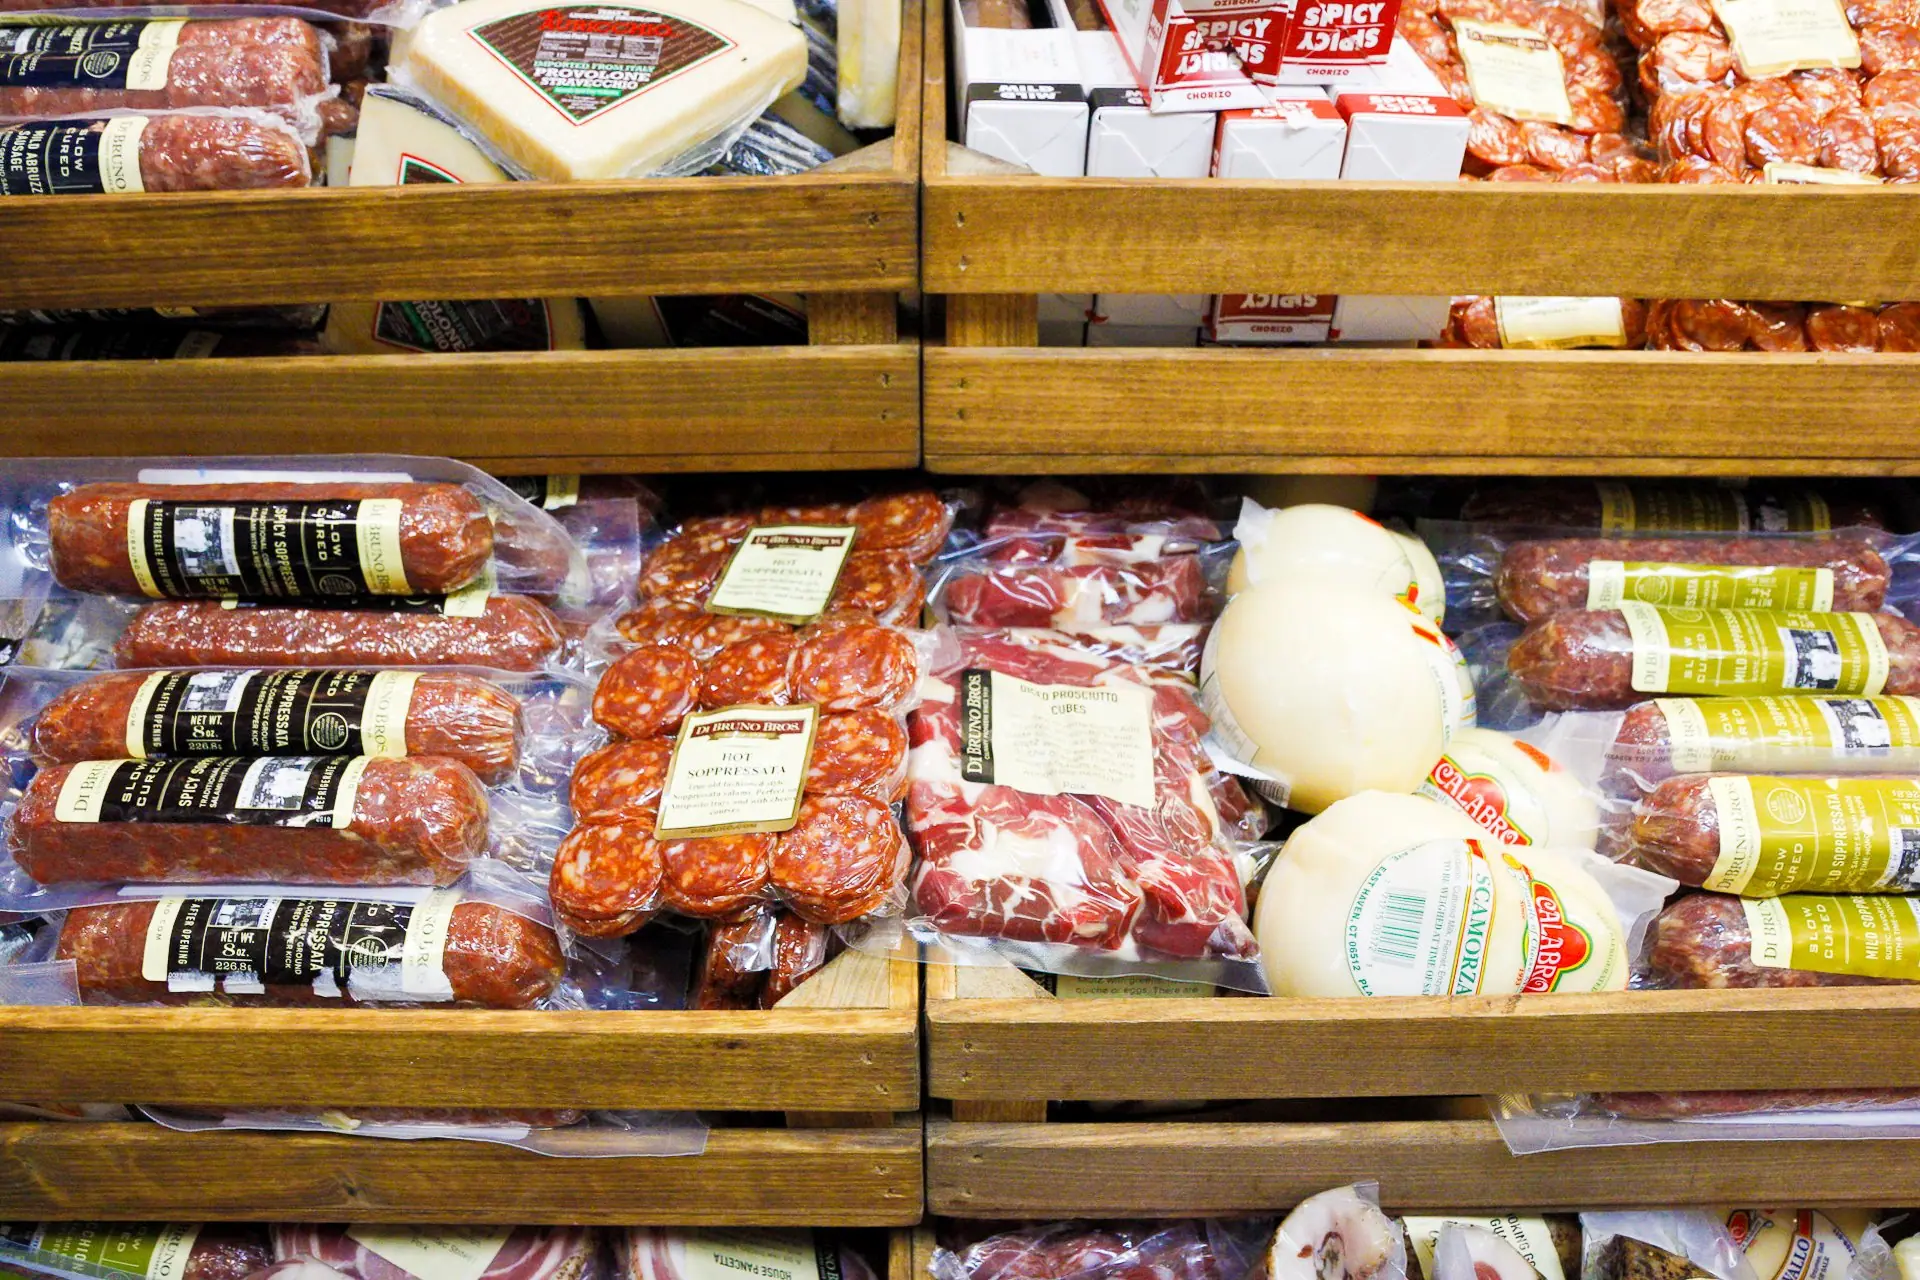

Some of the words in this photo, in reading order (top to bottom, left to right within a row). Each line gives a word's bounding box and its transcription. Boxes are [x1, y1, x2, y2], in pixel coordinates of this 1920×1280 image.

[533, 60, 590, 71] IMPORTED
[592, 63, 624, 72] FROM
[625, 64, 656, 74] ITALY
[533, 67, 652, 82] PROVOLONE
[1306, 67, 1350, 77] CHORIZO
[540, 76, 639, 90] STRAVECCHIO
[1186, 90, 1232, 100] CHORIZO
[10, 129, 29, 172] SAUSAGE
[27, 129, 47, 150] MILD
[74, 128, 90, 172] SLOW
[59, 127, 74, 177] CURED
[111, 133, 128, 189] BRUNO
[25, 151, 45, 195] ABRUZZ
[1250, 325, 1293, 333] CHORIZO
[152, 507, 165, 557] REFRIGERATE
[273, 507, 288, 538] SPICY
[1684, 637, 1695, 679] SLW
[1644, 669, 1658, 686] DI
[1734, 658, 1748, 684] MILD
[156, 692, 171, 712] AFTER
[257, 690, 265, 703] RED
[263, 687, 277, 720] COARSELY
[1052, 690, 1118, 703] PROSCIUTTO
[190, 715, 207, 725] NET
[209, 715, 223, 726] WT.
[251, 703, 262, 730] PEPPER
[276, 678, 302, 747] SOPPRESSATA
[1051, 704, 1087, 715] CUBES
[152, 713, 164, 748] OPENING
[192, 725, 205, 738] 8
[251, 729, 259, 747] KICK
[260, 720, 271, 751] GROUND
[696, 725, 710, 735] DI
[712, 720, 761, 732] BRUNO
[762, 721, 800, 732] BROS.
[966, 709, 982, 756] BRUNO
[722, 752, 753, 761] HOT
[967, 757, 983, 774] DI
[121, 762, 148, 803] SLOW
[136, 761, 166, 807] CURED
[688, 765, 787, 779] SOPPRESSATA
[178, 777, 201, 807] SPICY
[209, 782, 224, 808] SALAMI
[313, 765, 337, 810] REFRIGERATE
[673, 791, 721, 801] Soppressata
[755, 787, 786, 796] Perfect
[73, 795, 90, 812] DI
[732, 798, 749, 806] and
[1434, 762, 1520, 846] CALABRO
[1827, 793, 1848, 867] SOPPRESSATA
[1443, 860, 1452, 871] TO
[1717, 874, 1733, 890] DI
[1726, 827, 1747, 877] BRUNO
[1780, 842, 1804, 891] CURED
[1849, 842, 1861, 869] SAVORY
[1367, 865, 1387, 887] EAST
[1441, 872, 1450, 884] BE
[1766, 847, 1788, 889] SLOW
[183, 903, 199, 927] AFTER
[292, 907, 303, 920] RED
[1350, 888, 1371, 922] HAVEN,
[1434, 886, 1449, 931] WEIGHED
[1852, 896, 1876, 929] SOPPR
[220, 930, 238, 943] NET
[240, 931, 255, 944] WT.
[309, 901, 338, 971] OPPRESSATA
[1348, 925, 1358, 939] CT
[1432, 931, 1441, 943] AT
[1445, 919, 1456, 937] Milk,
[1456, 872, 1491, 995] SCAMORZA
[1802, 906, 1819, 954] SLOW
[1815, 904, 1834, 959] CURED
[178, 929, 193, 965] OPENING
[222, 942, 236, 957] 8
[1527, 896, 1564, 992] CALABRO
[1764, 942, 1778, 960] DI
[1864, 932, 1879, 960] MILD
[284, 950, 293, 969] KICK
[293, 941, 305, 975] GROUND
[1348, 941, 1361, 972] 06512
[1427, 945, 1439, 968] TIME
[1358, 978, 1374, 996] PLA
[1424, 970, 1434, 982] OF
[1515, 968, 1525, 986] 1953
[1153, 986, 1180, 995] There
[1507, 1213, 1530, 1251] OKING
[159, 1224, 190, 1277] BRUNO
[713, 1251, 759, 1275] PANCETTA
[761, 1265, 793, 1280] HOUSE
